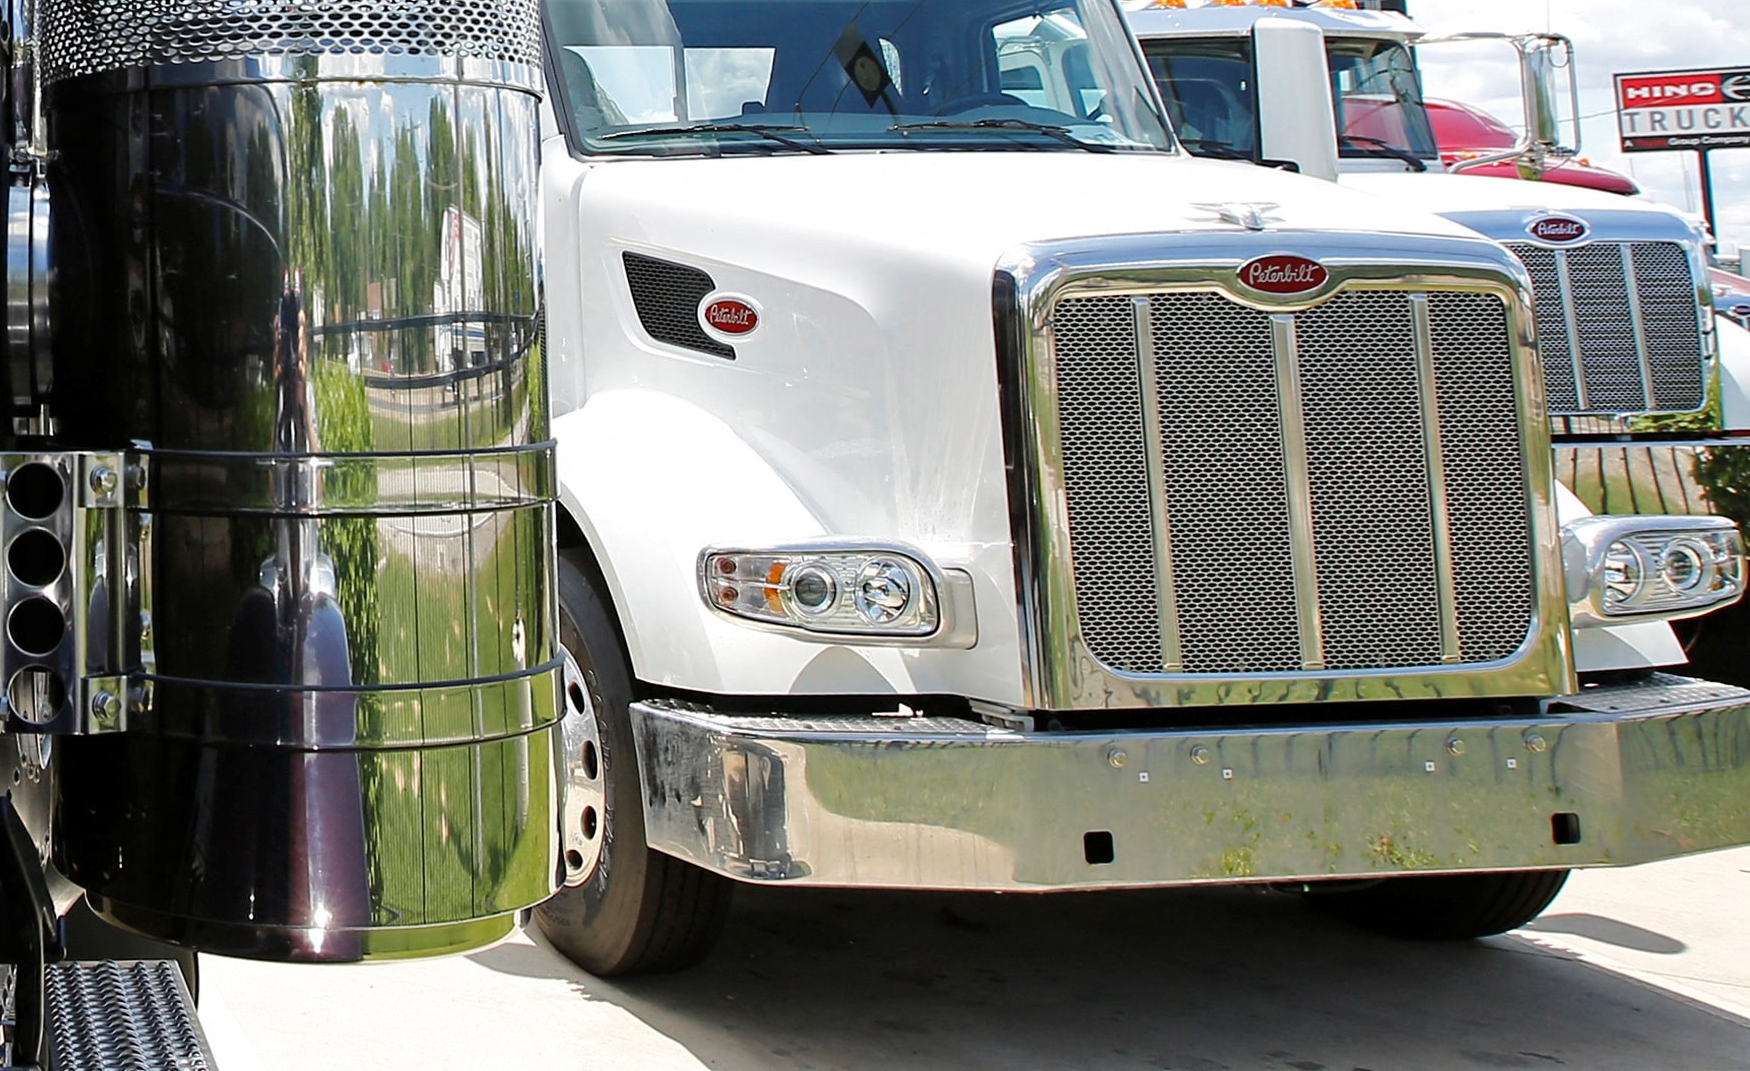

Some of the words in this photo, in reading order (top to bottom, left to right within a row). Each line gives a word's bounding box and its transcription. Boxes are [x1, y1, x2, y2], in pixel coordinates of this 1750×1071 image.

[1626, 82, 1716, 99] HINO
[1667, 137, 1701, 146] Group
[1700, 135, 1750, 146] Company
[1250, 262, 1320, 285] Peterbilt
[709, 304, 752, 325] Peterbilt
